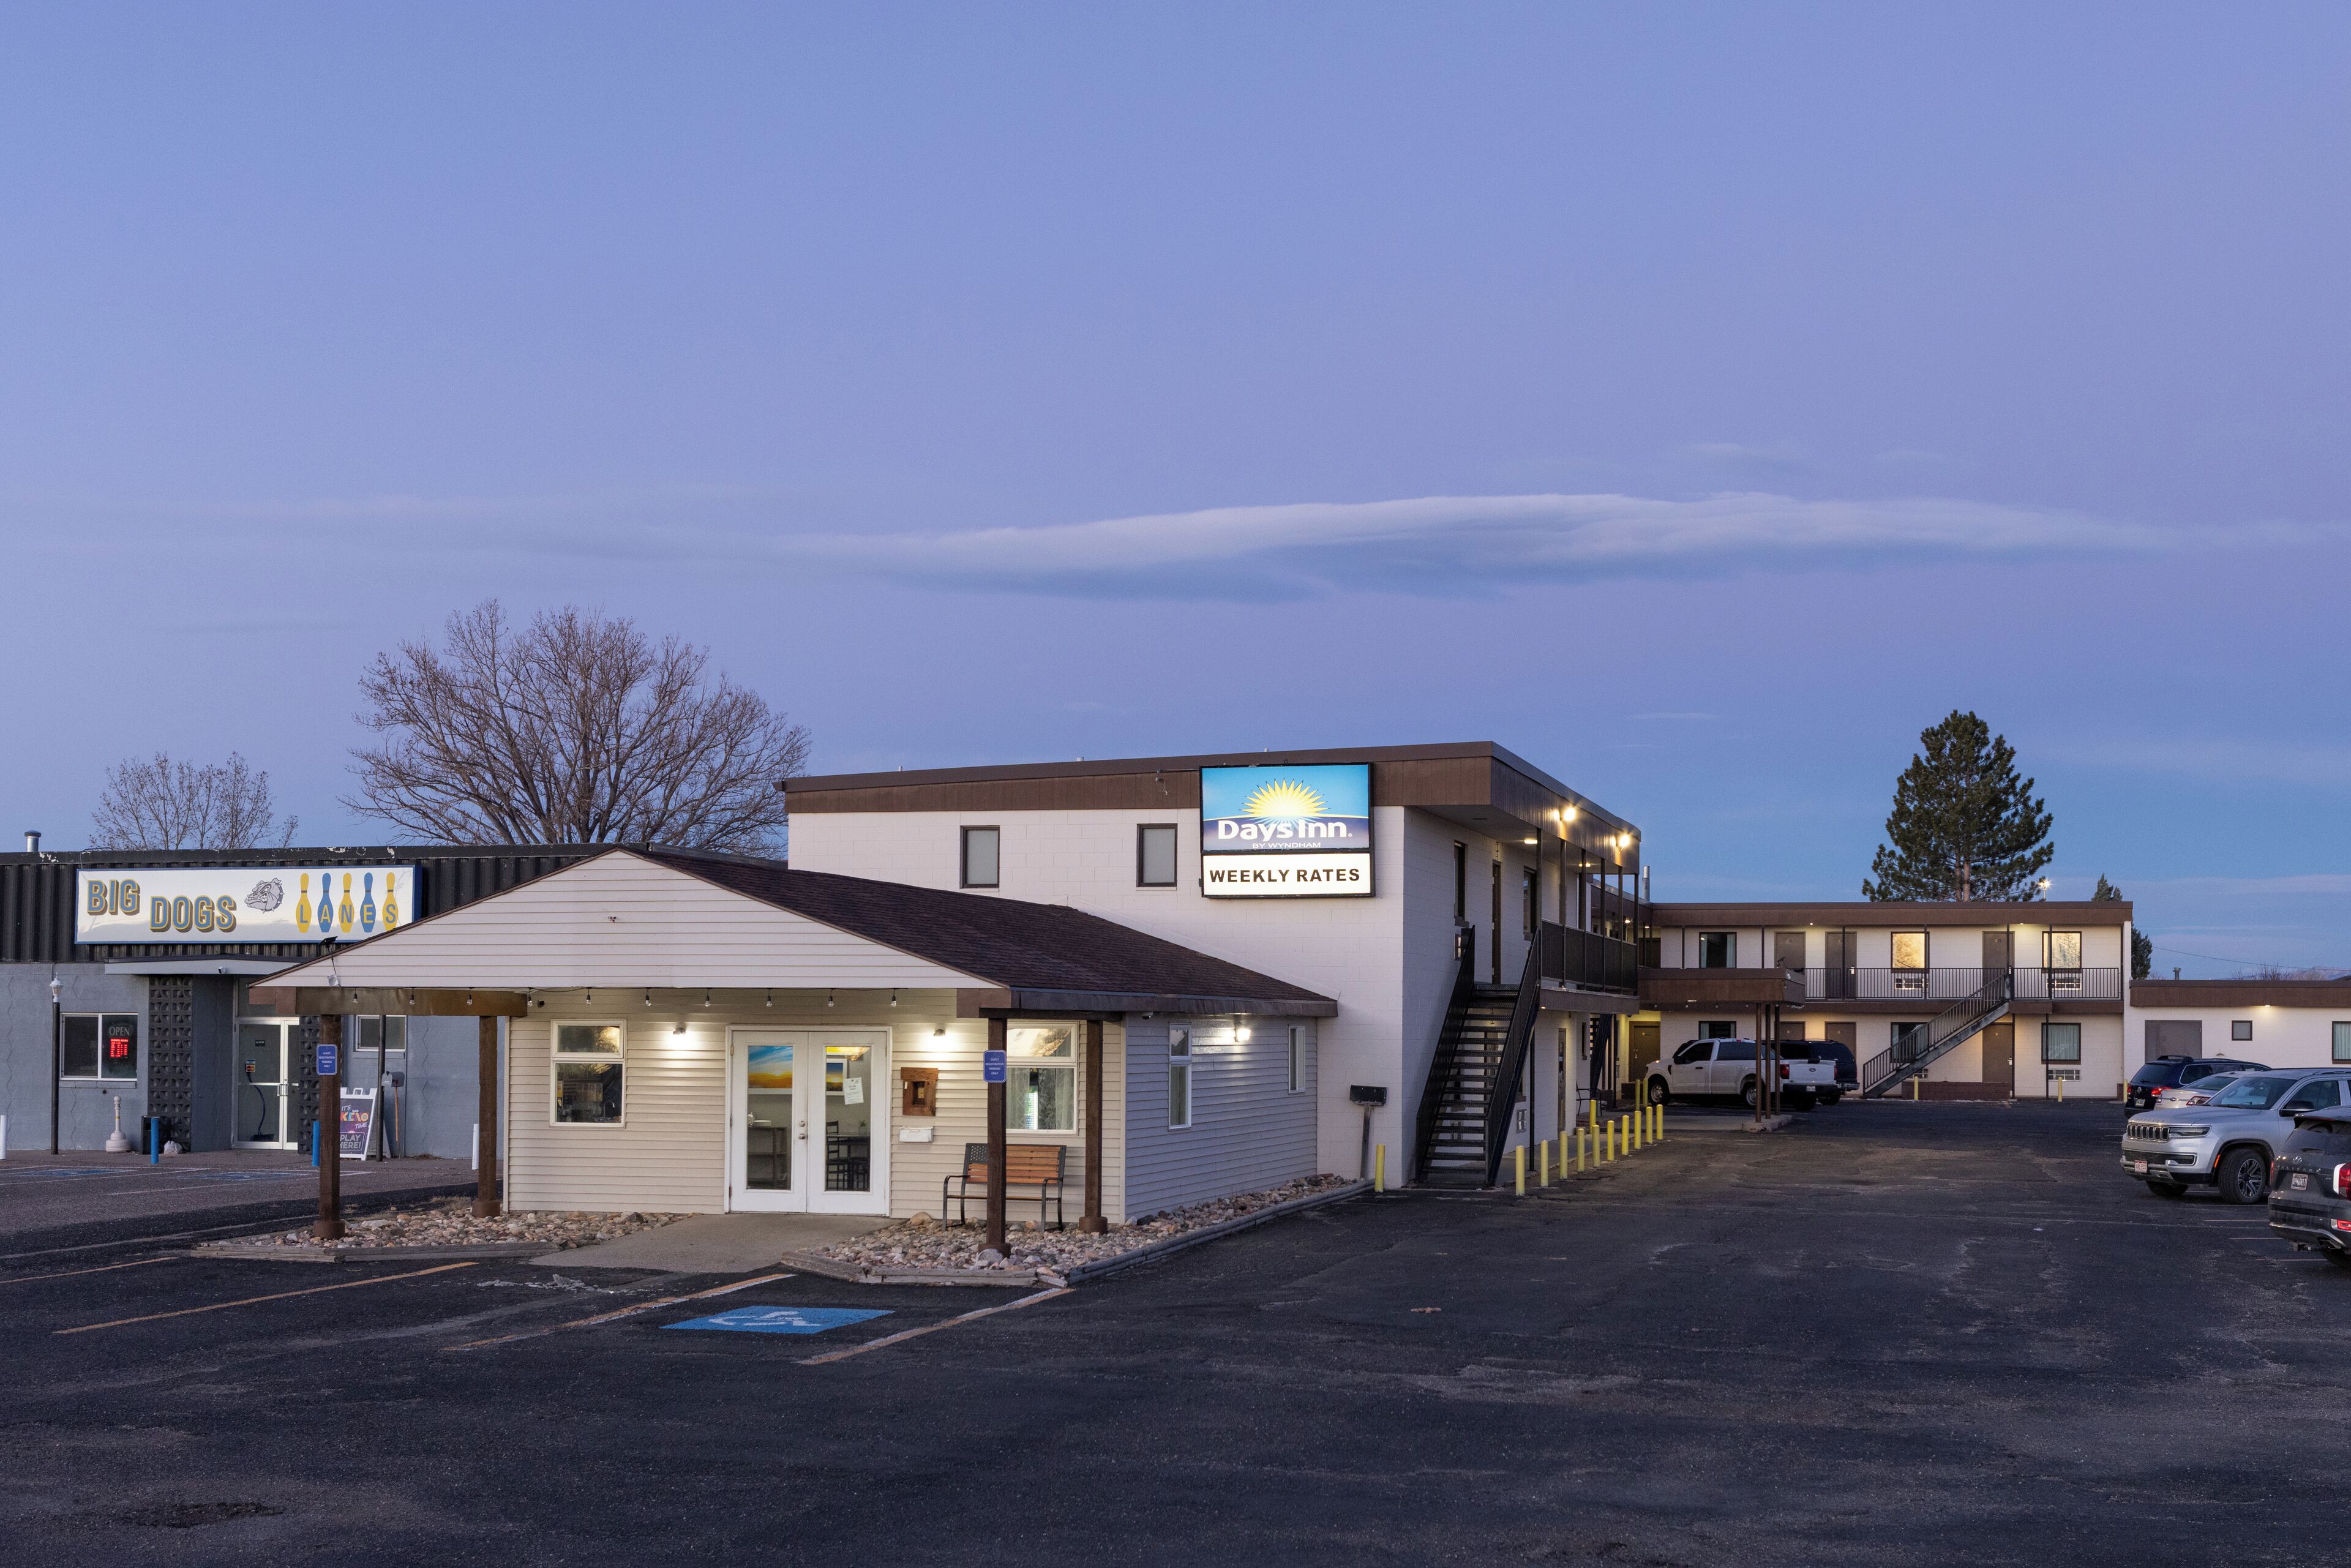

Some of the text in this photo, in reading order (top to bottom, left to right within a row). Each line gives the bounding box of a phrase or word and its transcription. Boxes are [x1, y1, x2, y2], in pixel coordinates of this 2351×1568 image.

[1218, 819, 1347, 842] Days Inn
[1209, 868, 1360, 883] WEEKLY RATES
[88, 879, 396, 933] BIG DOGS LANES
[109, 1026, 130, 1036] OPEN
[340, 1111, 369, 1122] KENO
